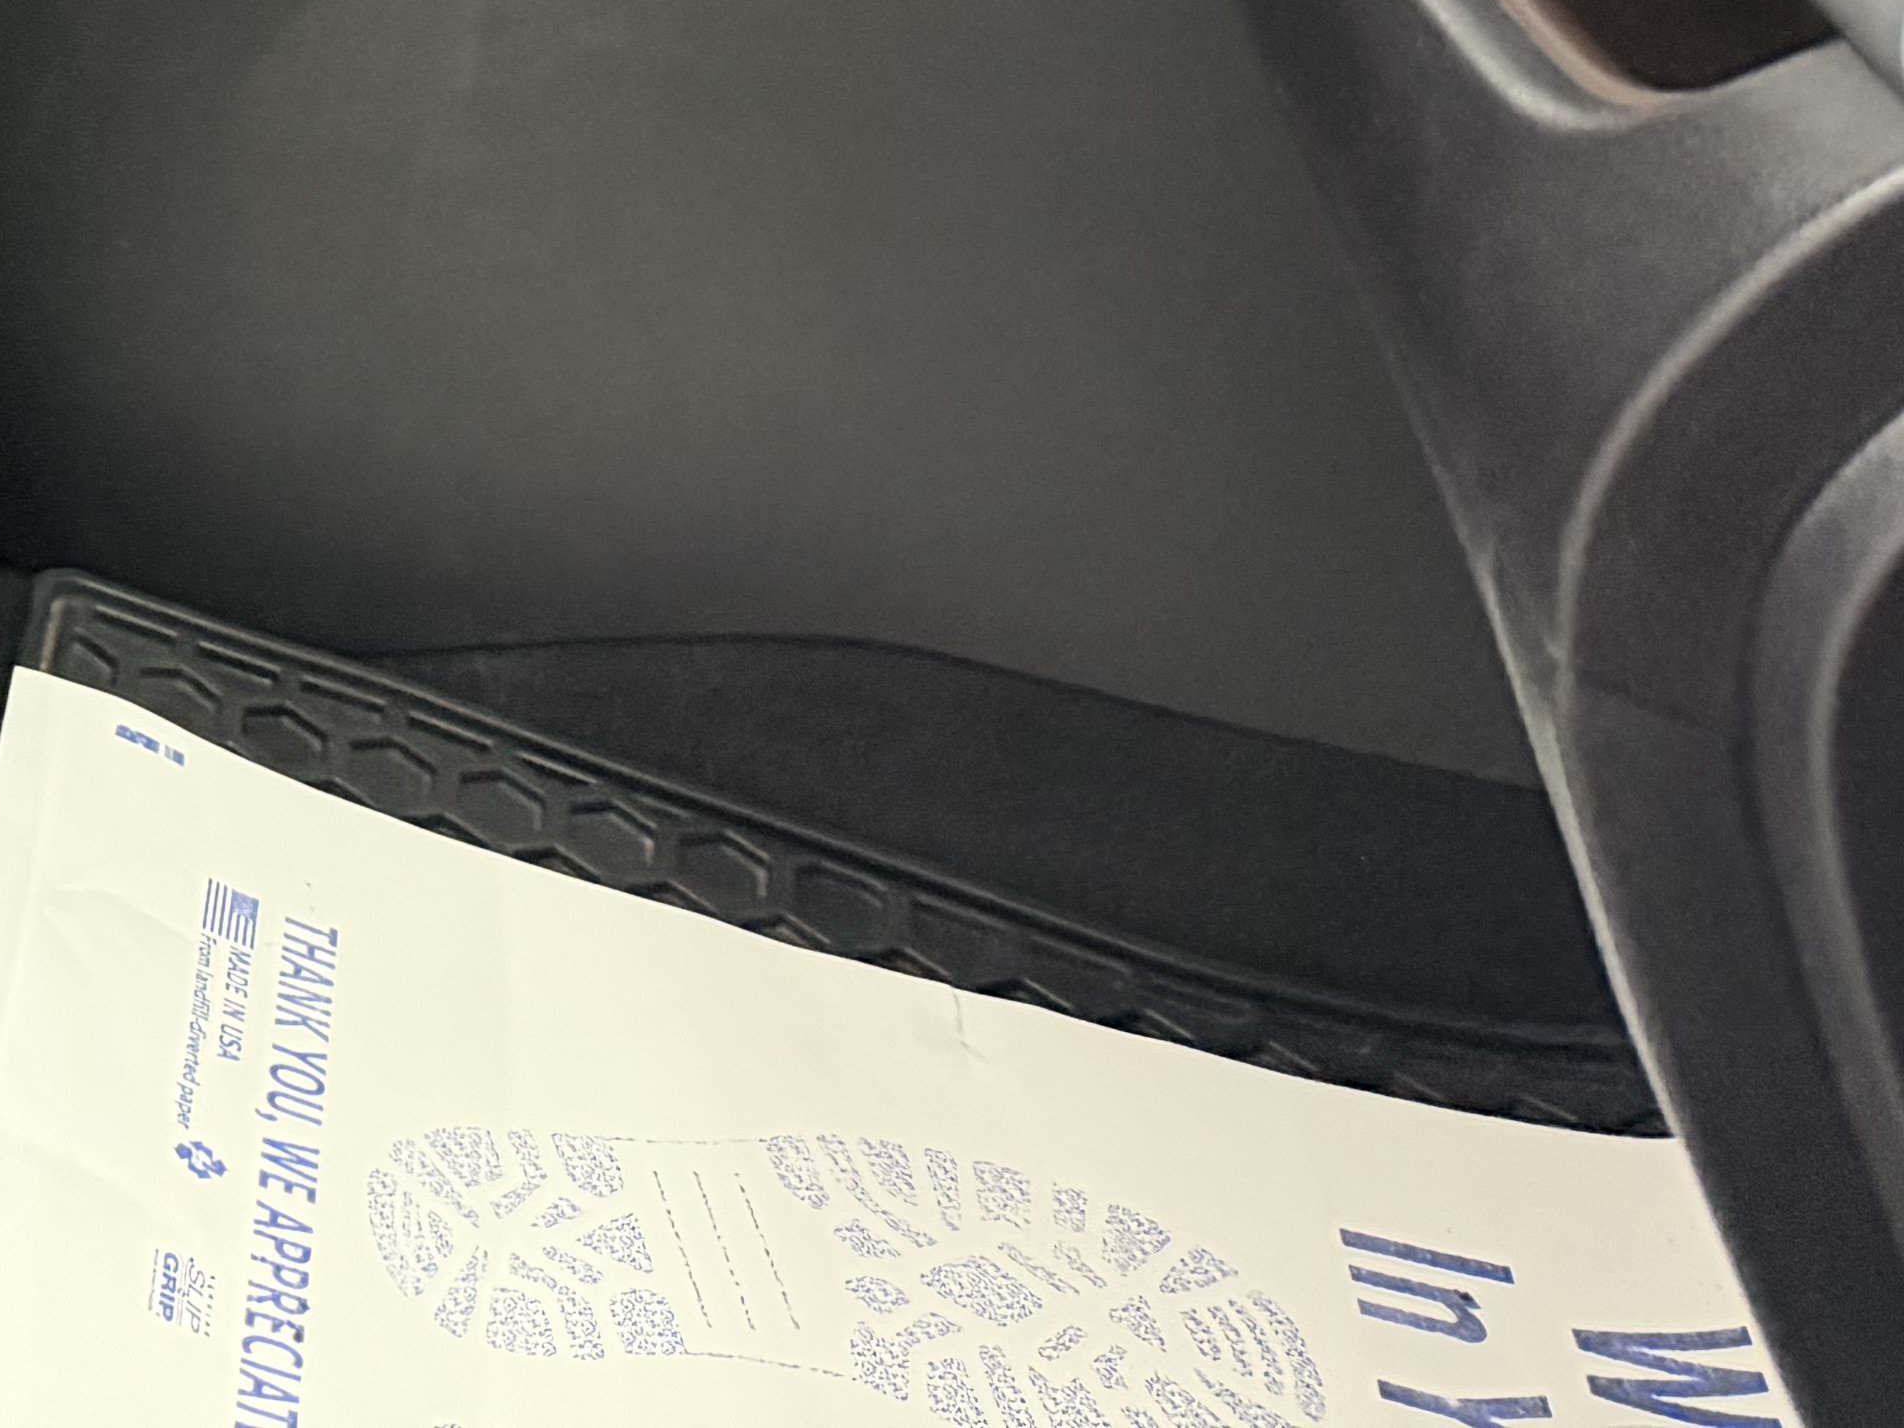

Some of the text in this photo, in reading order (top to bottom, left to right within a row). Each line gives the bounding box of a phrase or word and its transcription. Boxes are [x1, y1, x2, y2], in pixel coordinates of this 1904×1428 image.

[175, 932, 217, 1131] From landfill-diverted paper
[217, 945, 252, 1062] MADE IN USA
[234, 915, 339, 1428] THANK YOU, WE APPRECIAT
[159, 1252, 179, 1322] GRIP
[185, 1259, 206, 1334] SLIP
[1339, 1227, 1515, 1343] In
